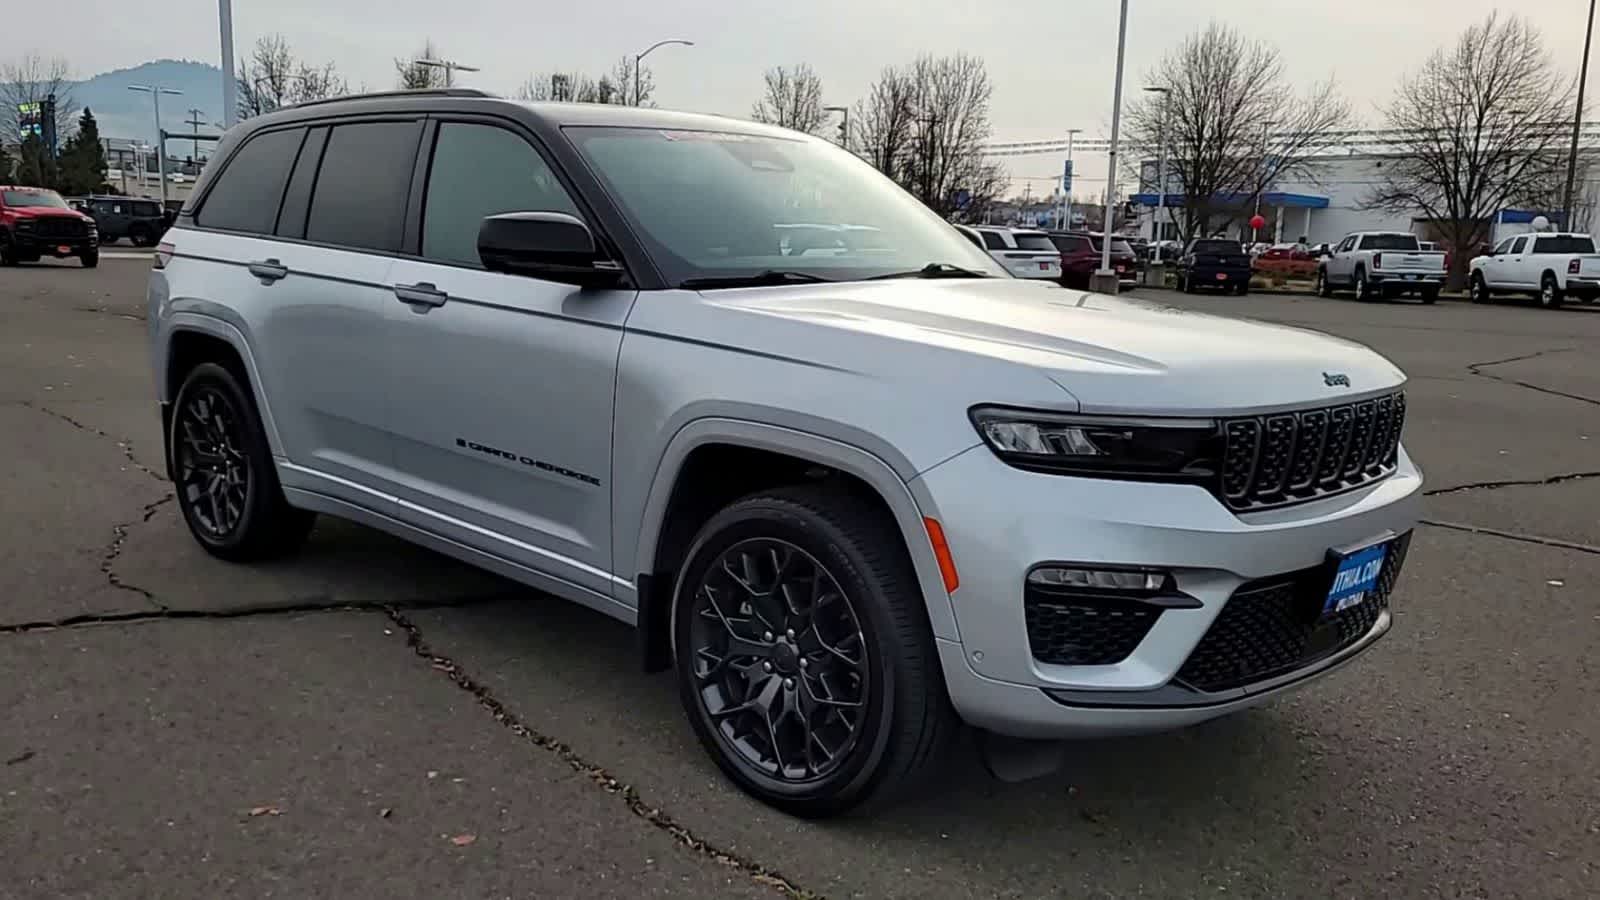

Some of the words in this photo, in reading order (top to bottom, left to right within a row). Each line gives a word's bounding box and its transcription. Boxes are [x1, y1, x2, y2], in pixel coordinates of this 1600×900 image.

[1322, 372, 1350, 387] Jeep
[468, 441, 517, 461] GRAND
[519, 456, 600, 486] CHEROKEE
